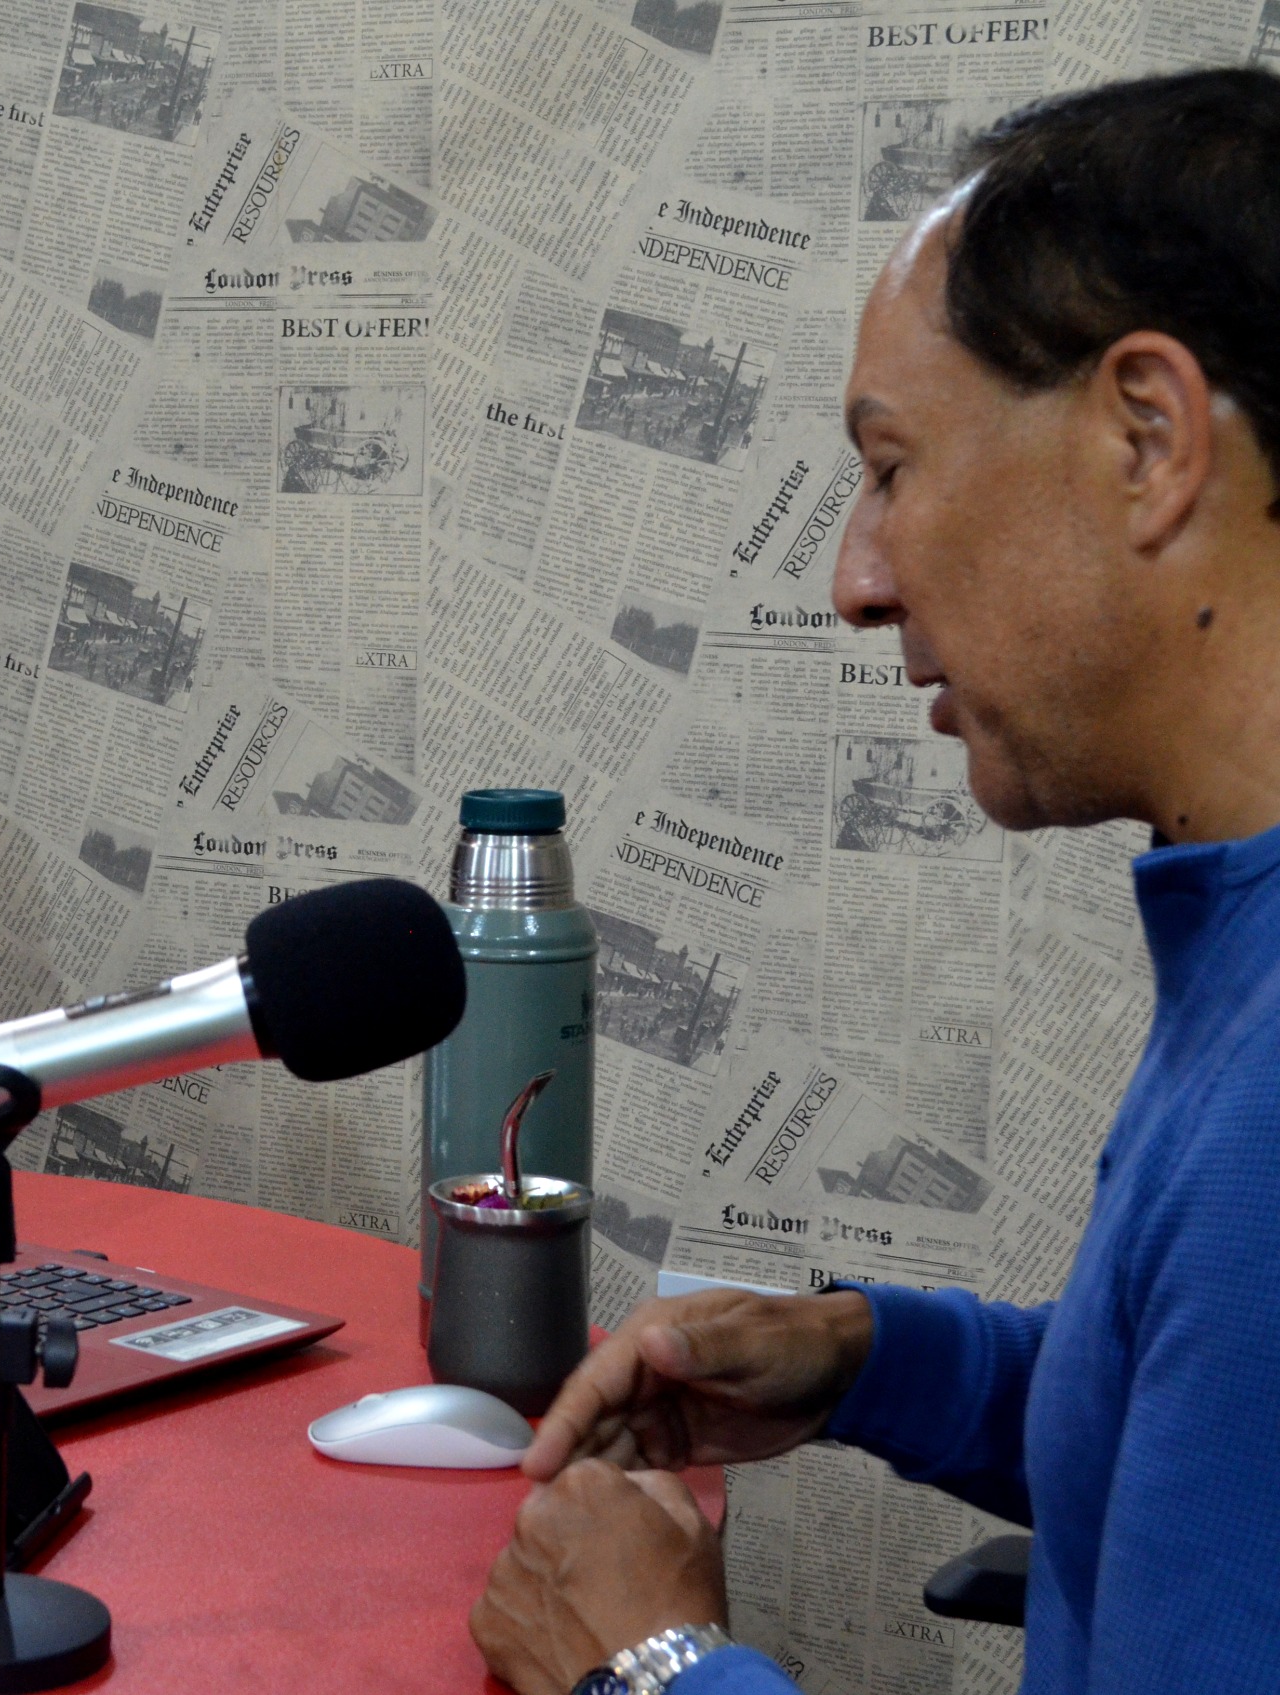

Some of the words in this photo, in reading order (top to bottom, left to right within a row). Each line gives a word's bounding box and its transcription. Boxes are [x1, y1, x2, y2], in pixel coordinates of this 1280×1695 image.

[867, 23, 938, 48] BEST
[946, 18, 1050, 44] OFFER!
[369, 61, 425, 80] EXTRA
[8, 100, 45, 129] first
[188, 131, 253, 234] Enterprise
[232, 126, 301, 246] RESOURCES
[676, 197, 812, 252] Independence
[205, 266, 279, 293] London
[290, 265, 353, 289] Press
[281, 317, 339, 339] BEST
[344, 317, 429, 340] OFFER!
[486, 402, 518, 427] the
[522, 408, 566, 441] first
[125, 466, 240, 518] Independence
[733, 459, 810, 565] Enterprise
[783, 456, 864, 580] RESOURCES
[750, 603, 839, 631] London
[5, 650, 41, 680] first
[839, 662, 907, 686] BEST
[179, 704, 241, 797] Enterprise
[220, 701, 289, 812] RESOURCES
[193, 831, 267, 856] London
[277, 835, 338, 860] Press
[649, 808, 785, 872] Independence
[918, 1026, 984, 1046] EXTRA
[705, 1070, 781, 1166] Enterprise
[755, 1072, 838, 1185] RESOURCES
[339, 1213, 391, 1231] EXTRA
[721, 1203, 809, 1235] London
[820, 1215, 893, 1246] Press
[884, 1620, 945, 1644] EXTRA
